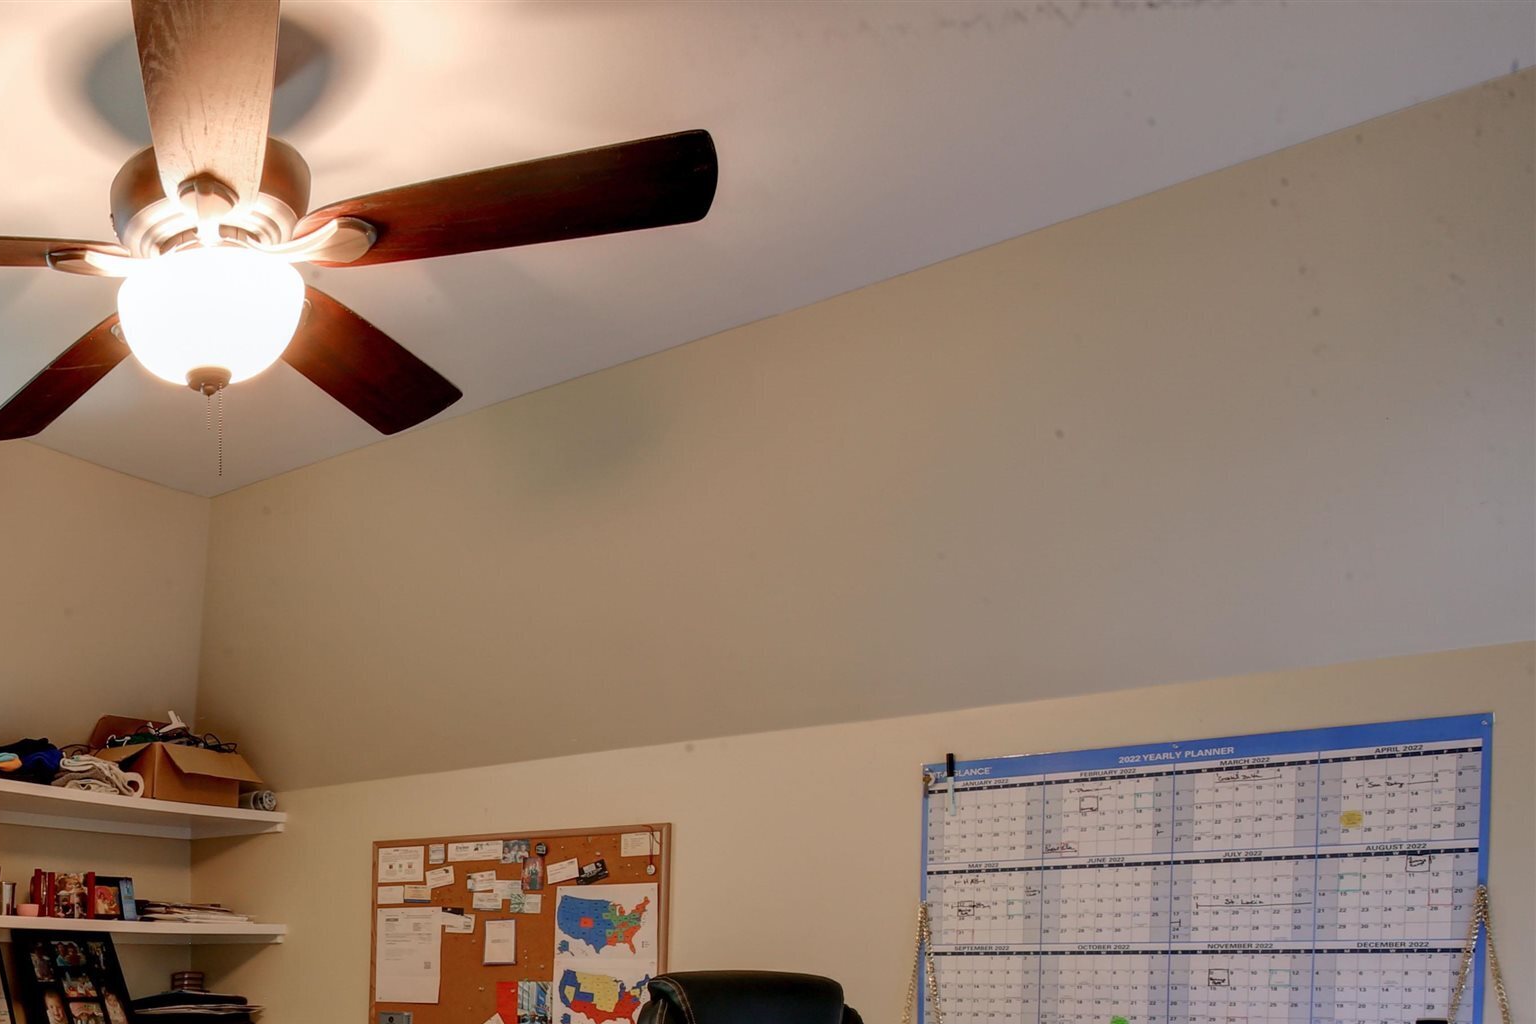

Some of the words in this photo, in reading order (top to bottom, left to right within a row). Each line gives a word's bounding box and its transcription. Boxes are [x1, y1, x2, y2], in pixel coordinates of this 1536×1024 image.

[1118, 756, 1141, 764] 2022
[1142, 751, 1182, 762] YEARLY
[1184, 747, 1234, 758] PLANNER
